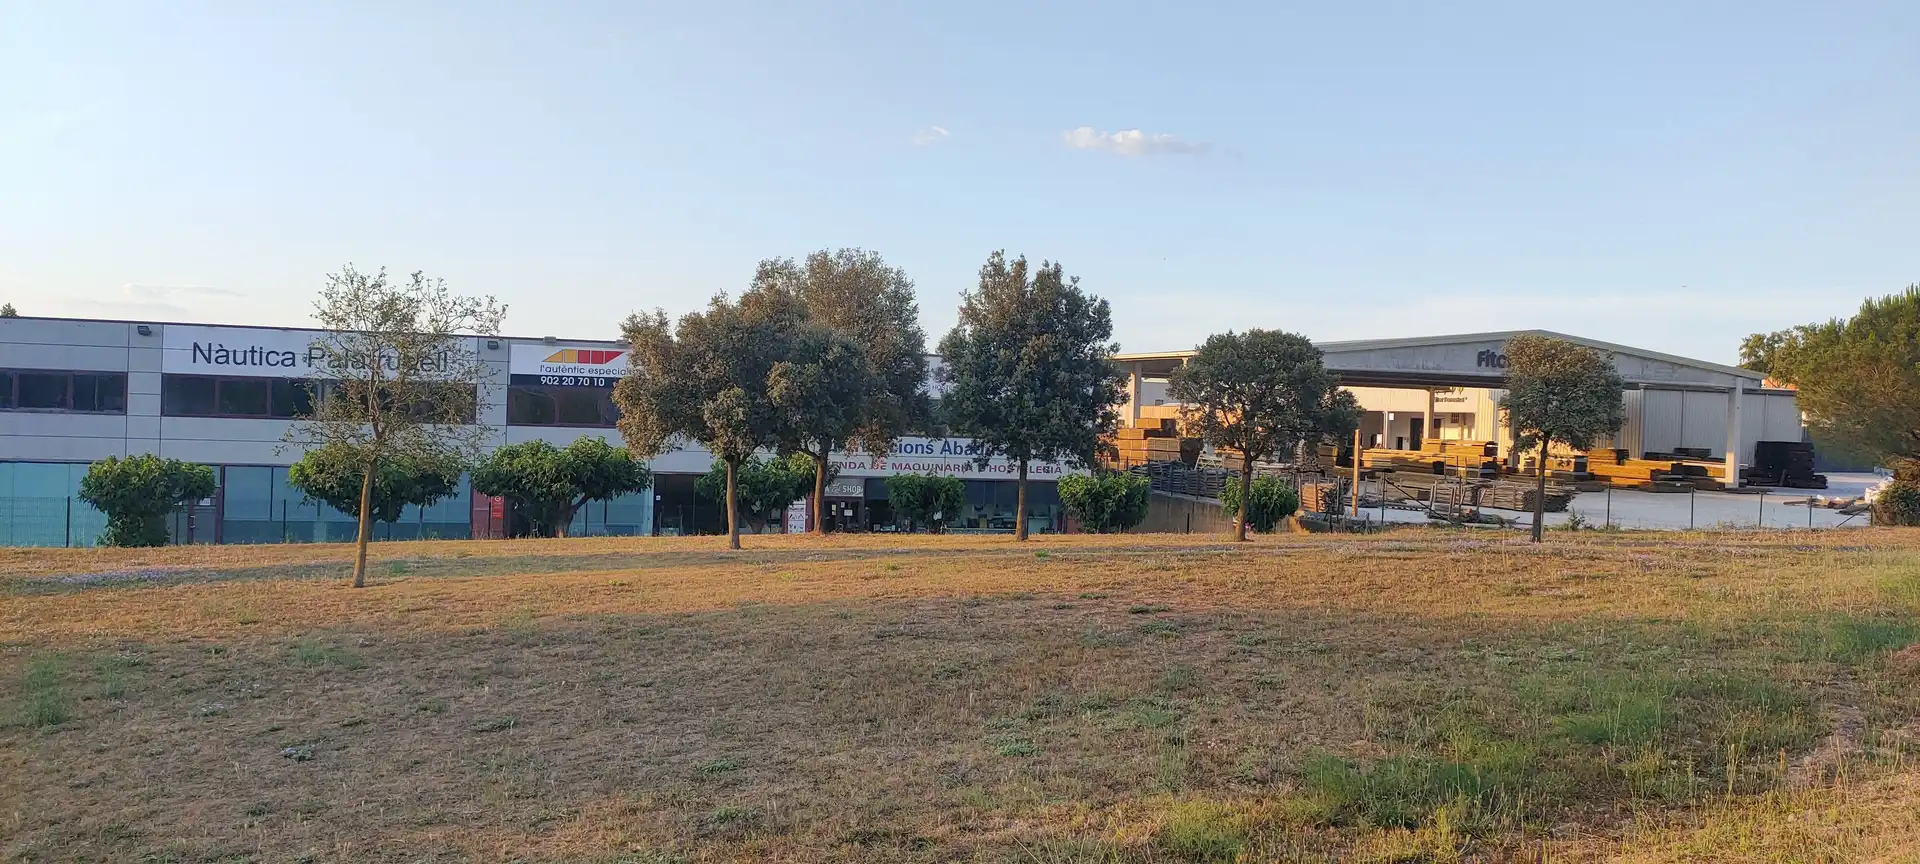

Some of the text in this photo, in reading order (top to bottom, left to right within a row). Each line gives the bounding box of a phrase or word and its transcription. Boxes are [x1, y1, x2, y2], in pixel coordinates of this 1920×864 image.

[192, 341, 448, 374] Nàutica Palaruell
[540, 365, 586, 374] l'autèntic
[540, 376, 605, 387] 902 20 70 10
[892, 462, 974, 474] MAQUINARIA
